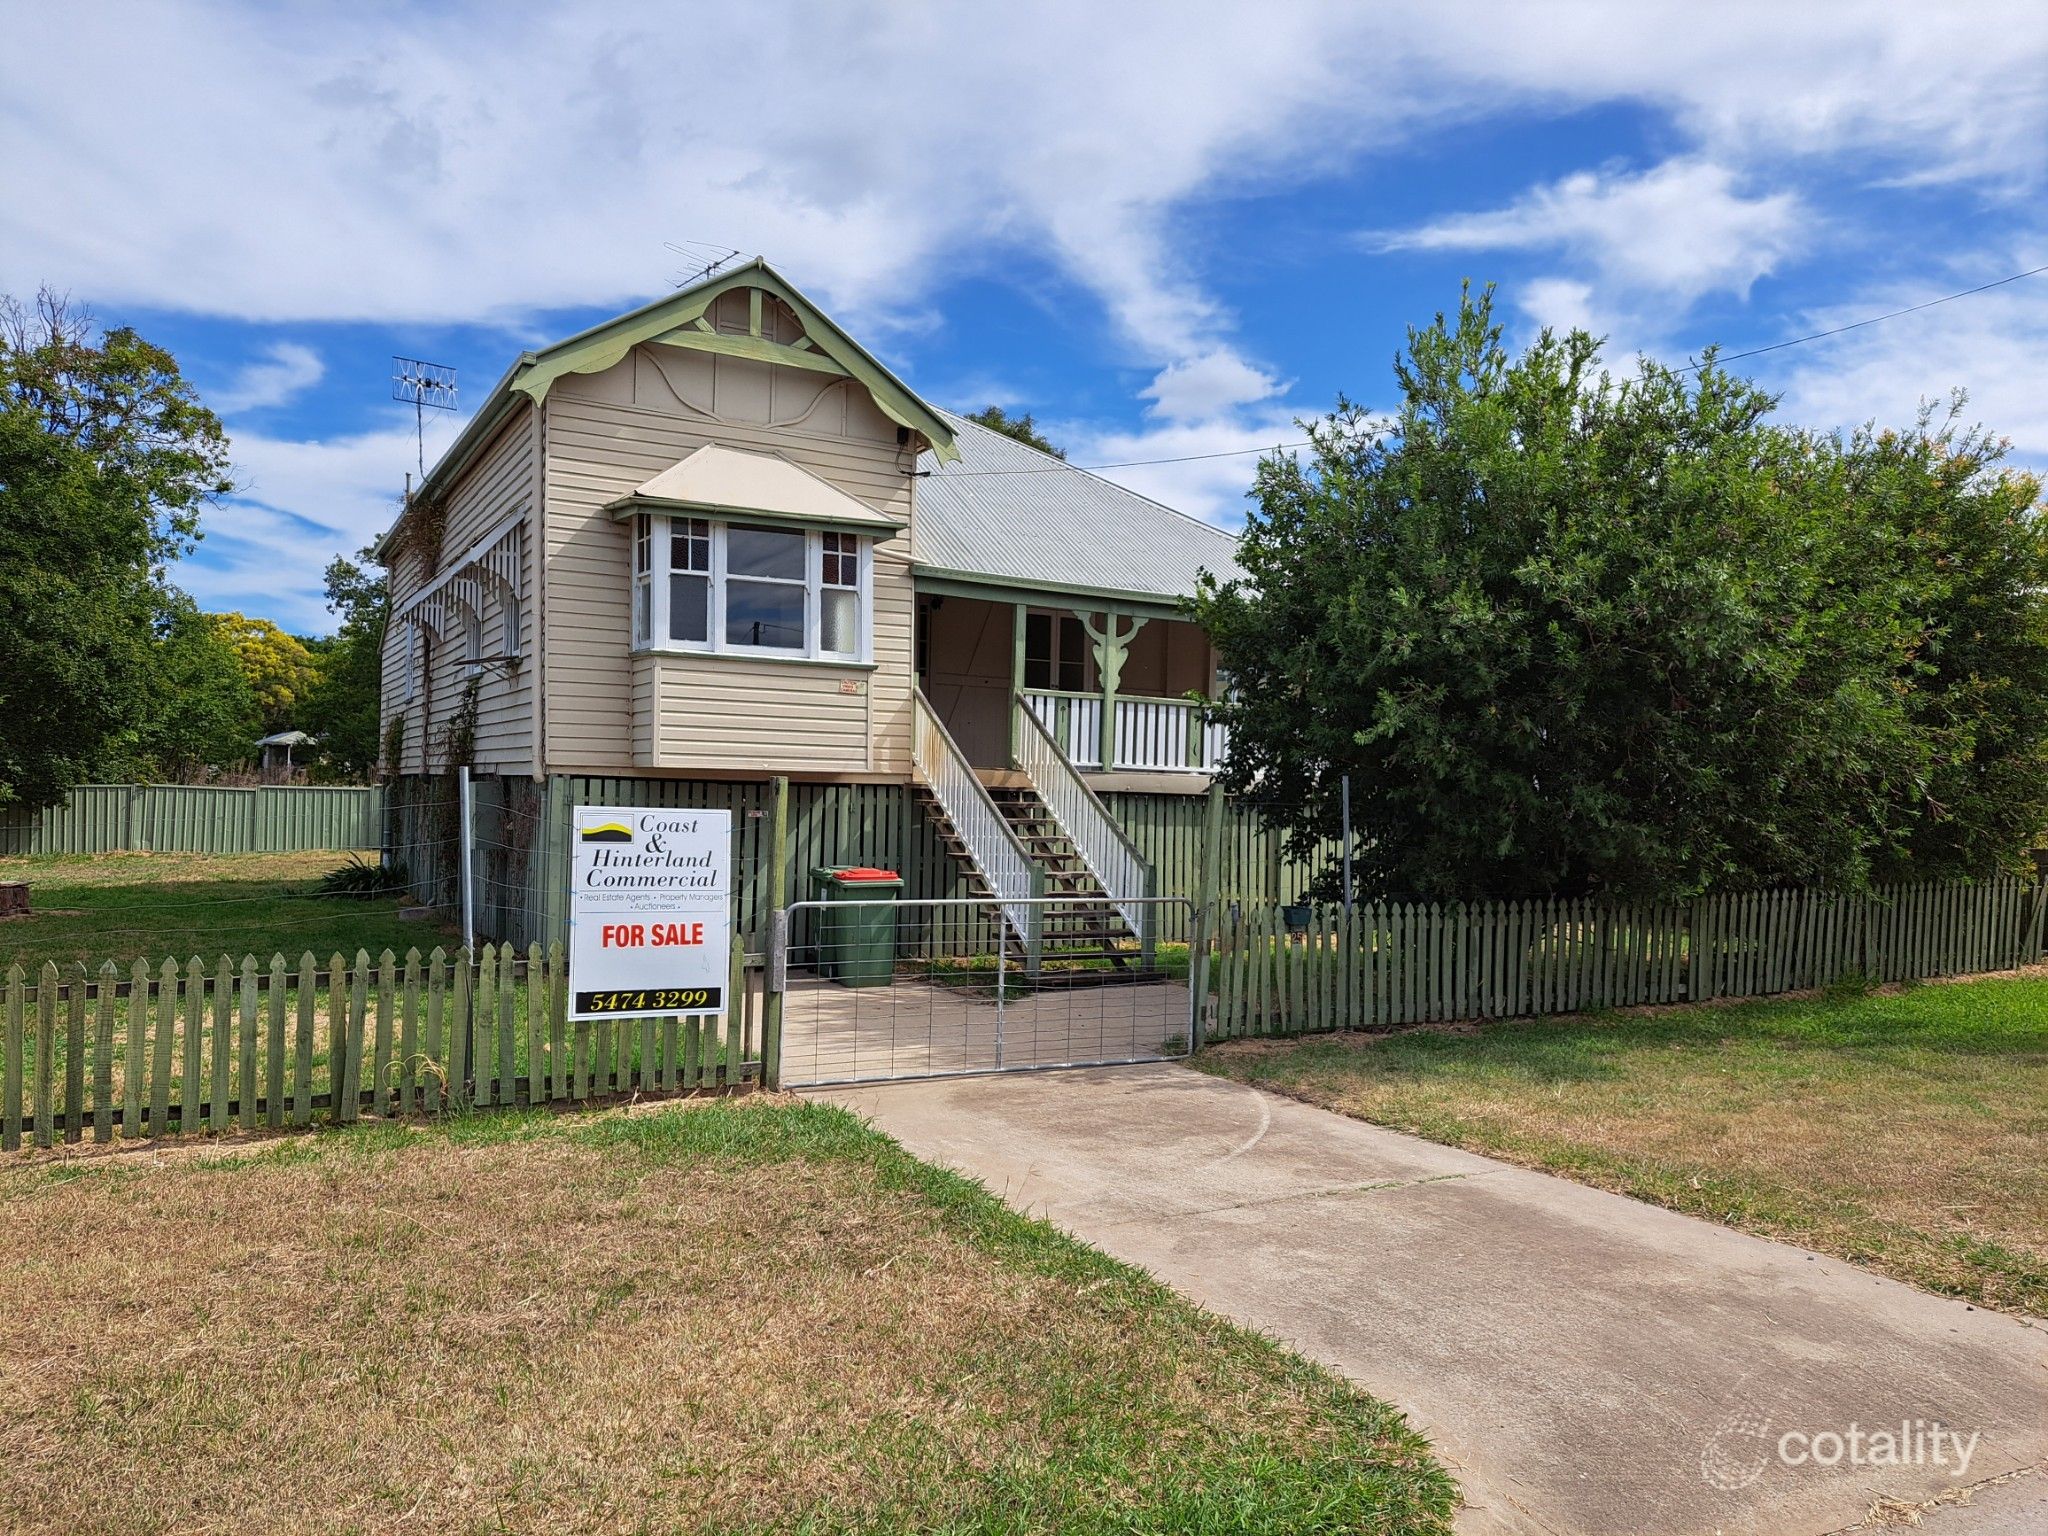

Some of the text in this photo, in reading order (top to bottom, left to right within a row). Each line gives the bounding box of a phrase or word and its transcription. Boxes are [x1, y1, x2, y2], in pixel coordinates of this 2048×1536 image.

[640, 815, 698, 832] Coast
[645, 833, 666, 853] &
[592, 849, 712, 868] Hinterland
[586, 870, 717, 888] Commercial
[602, 893, 624, 901] Estate
[625, 893, 650, 902] Agents
[660, 894, 688, 902] Property
[689, 894, 723, 902] Managers
[602, 923, 703, 948] FOR SALE
[590, 990, 707, 1011] 5474 3299
